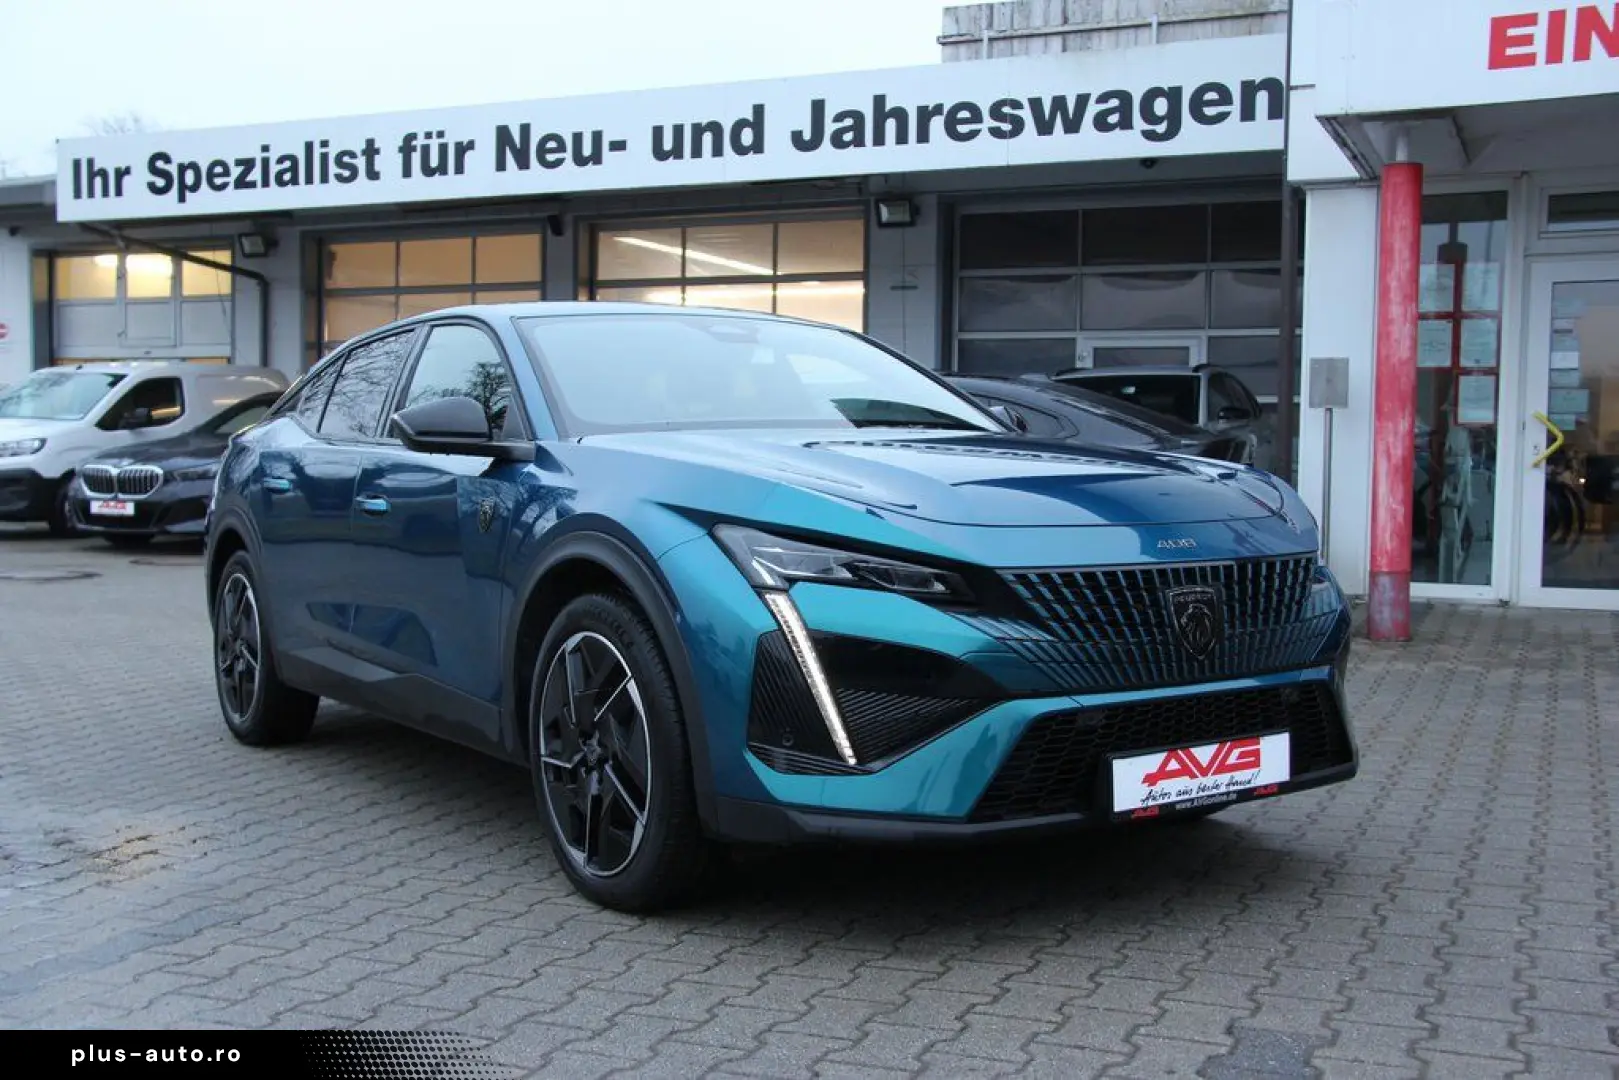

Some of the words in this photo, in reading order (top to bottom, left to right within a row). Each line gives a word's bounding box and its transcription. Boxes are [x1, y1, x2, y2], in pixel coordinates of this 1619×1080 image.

[1487, 3, 1619, 70] EIN
[72, 157, 132, 200] Ihr
[146, 138, 381, 203] Spezialist
[398, 131, 475, 179] für
[495, 121, 628, 172] Neu-
[651, 102, 765, 162] und
[790, 77, 1285, 153] Jahreswagen
[1142, 736, 1262, 787] AVG
